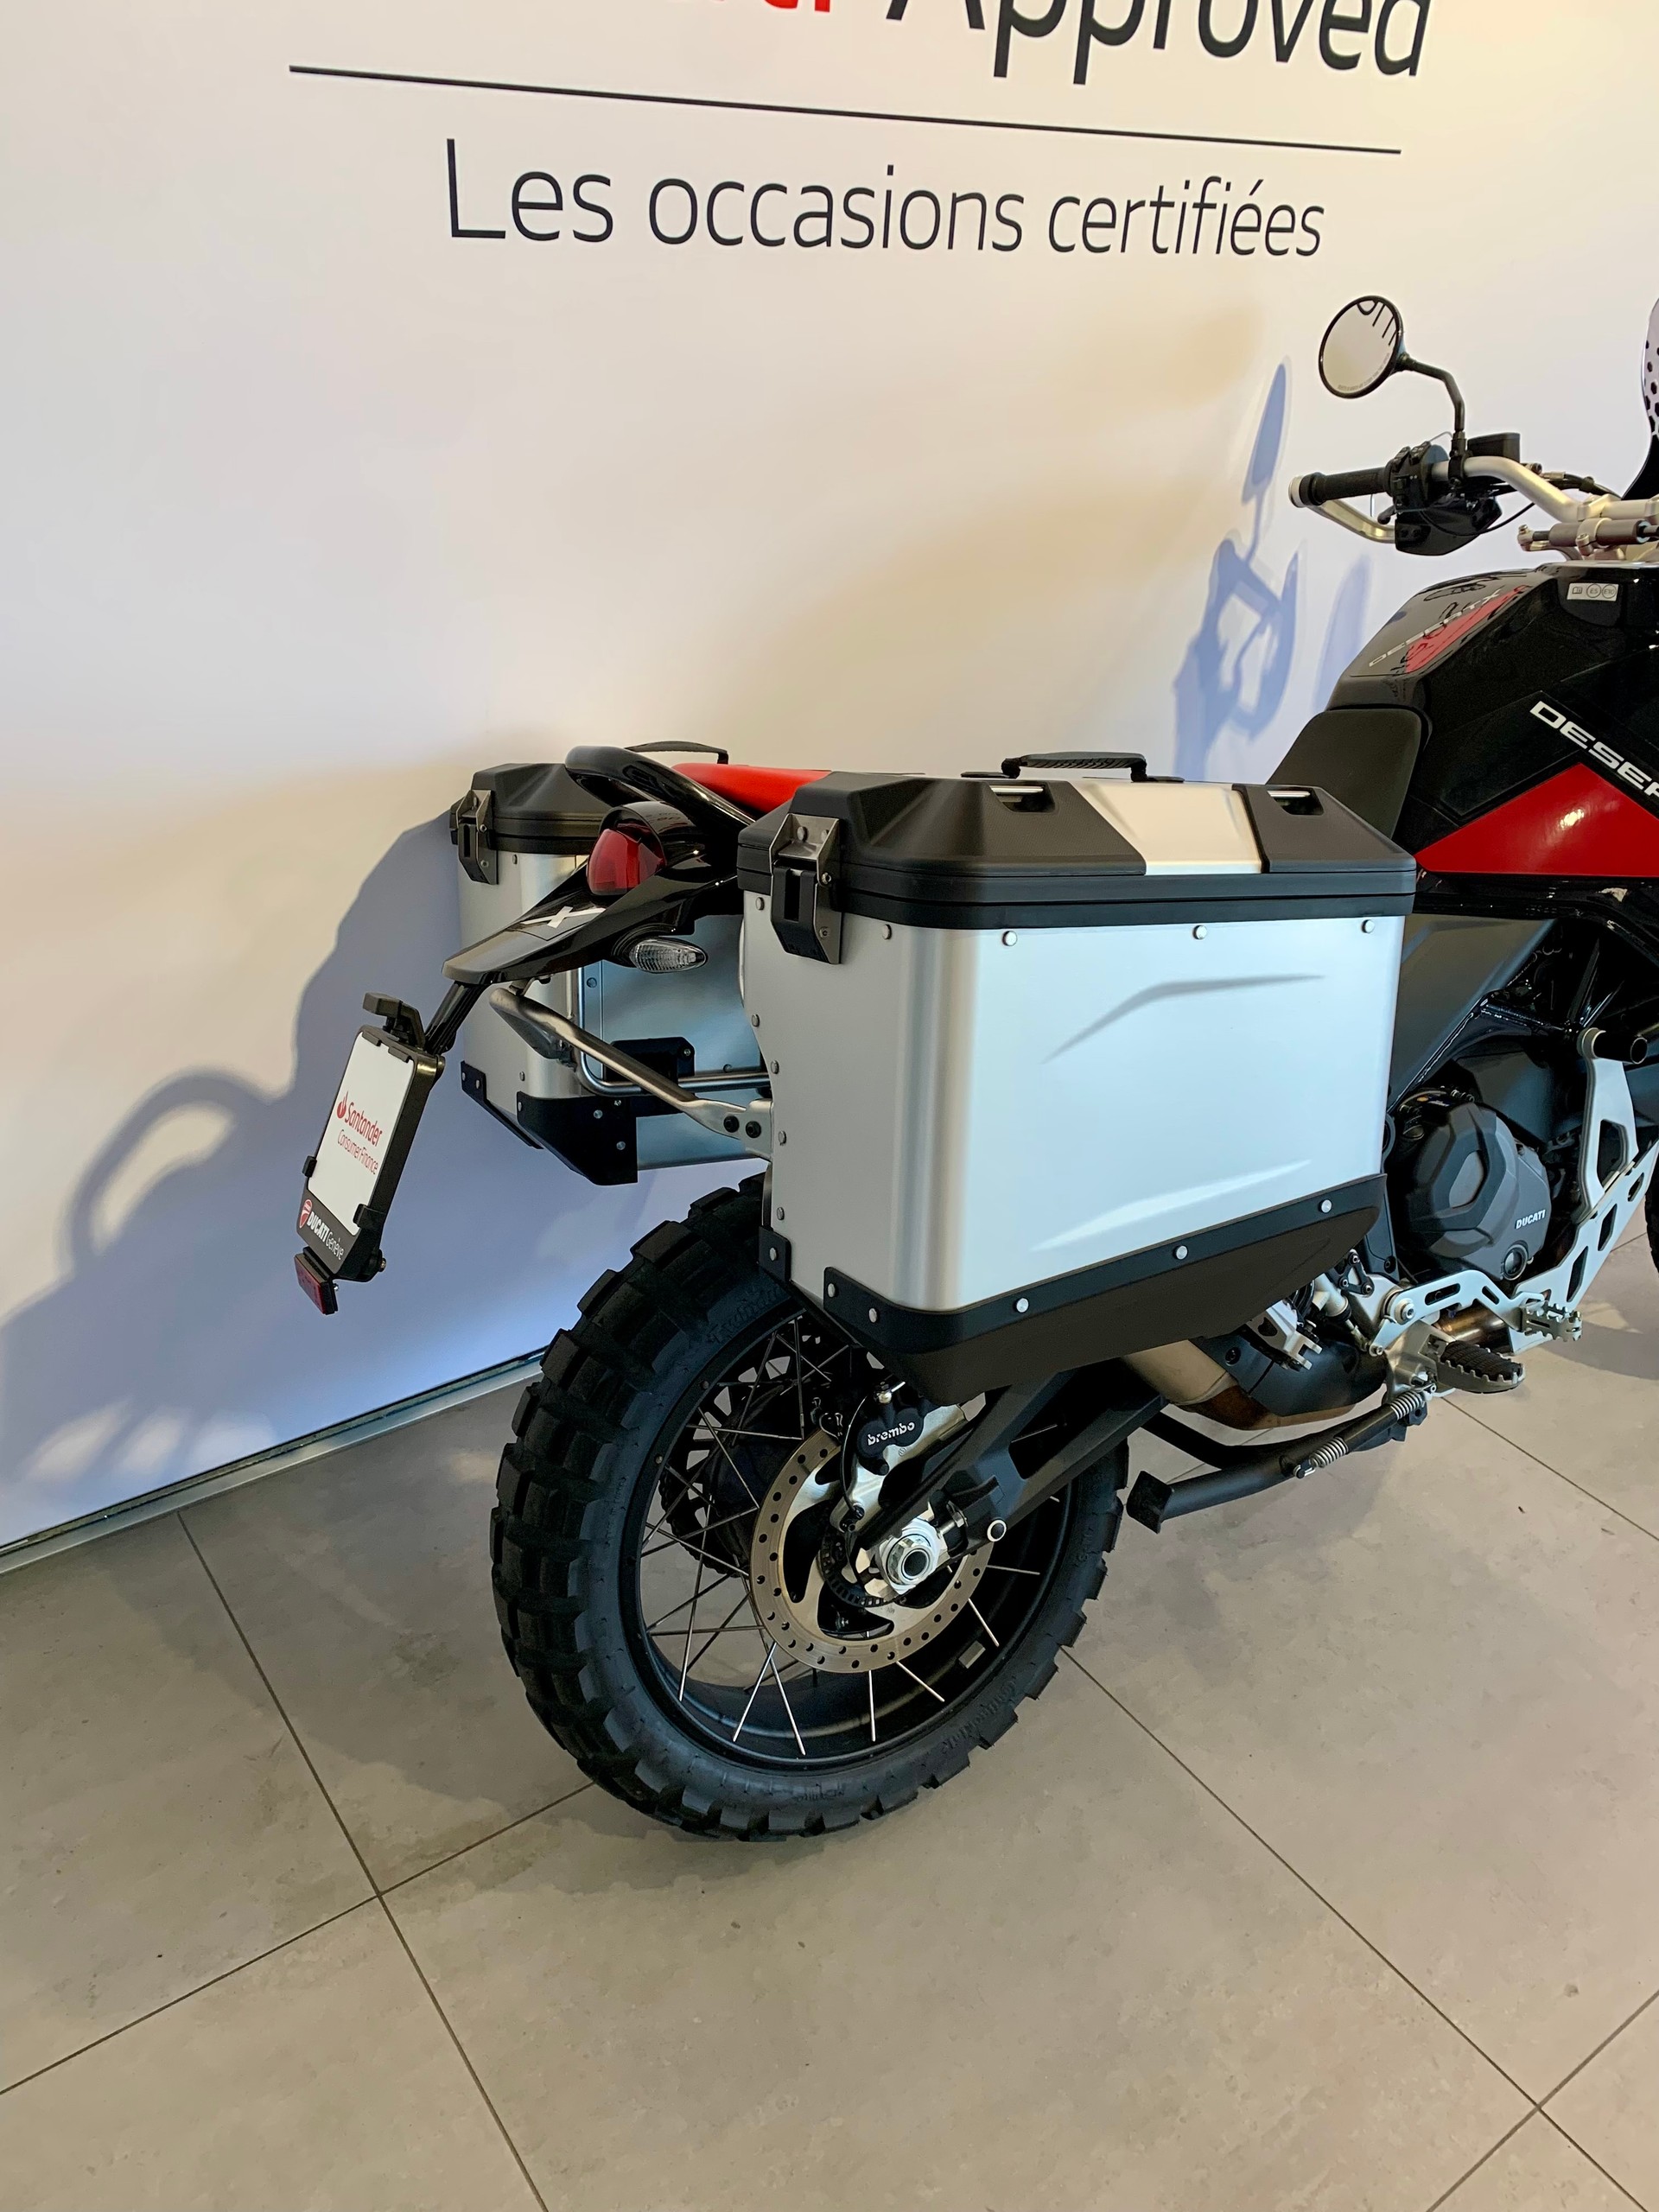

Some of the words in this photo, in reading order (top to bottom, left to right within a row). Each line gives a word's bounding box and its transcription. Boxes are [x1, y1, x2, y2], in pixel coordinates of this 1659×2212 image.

[886, 0, 1430, 86] pproved
[448, 139, 613, 242] Les
[650, 165, 1024, 251] occasions
[1049, 176, 1324, 256] certifiées
[344, 1102, 383, 1147] Santander
[337, 1128, 362, 1162] Consumer
[360, 1146, 378, 1175] Finance
[307, 1211, 330, 1243] DUCATI
[326, 1231, 345, 1261] Genève
[1516, 1209, 1546, 1230] DUCATI
[867, 1421, 916, 1446] brembo
